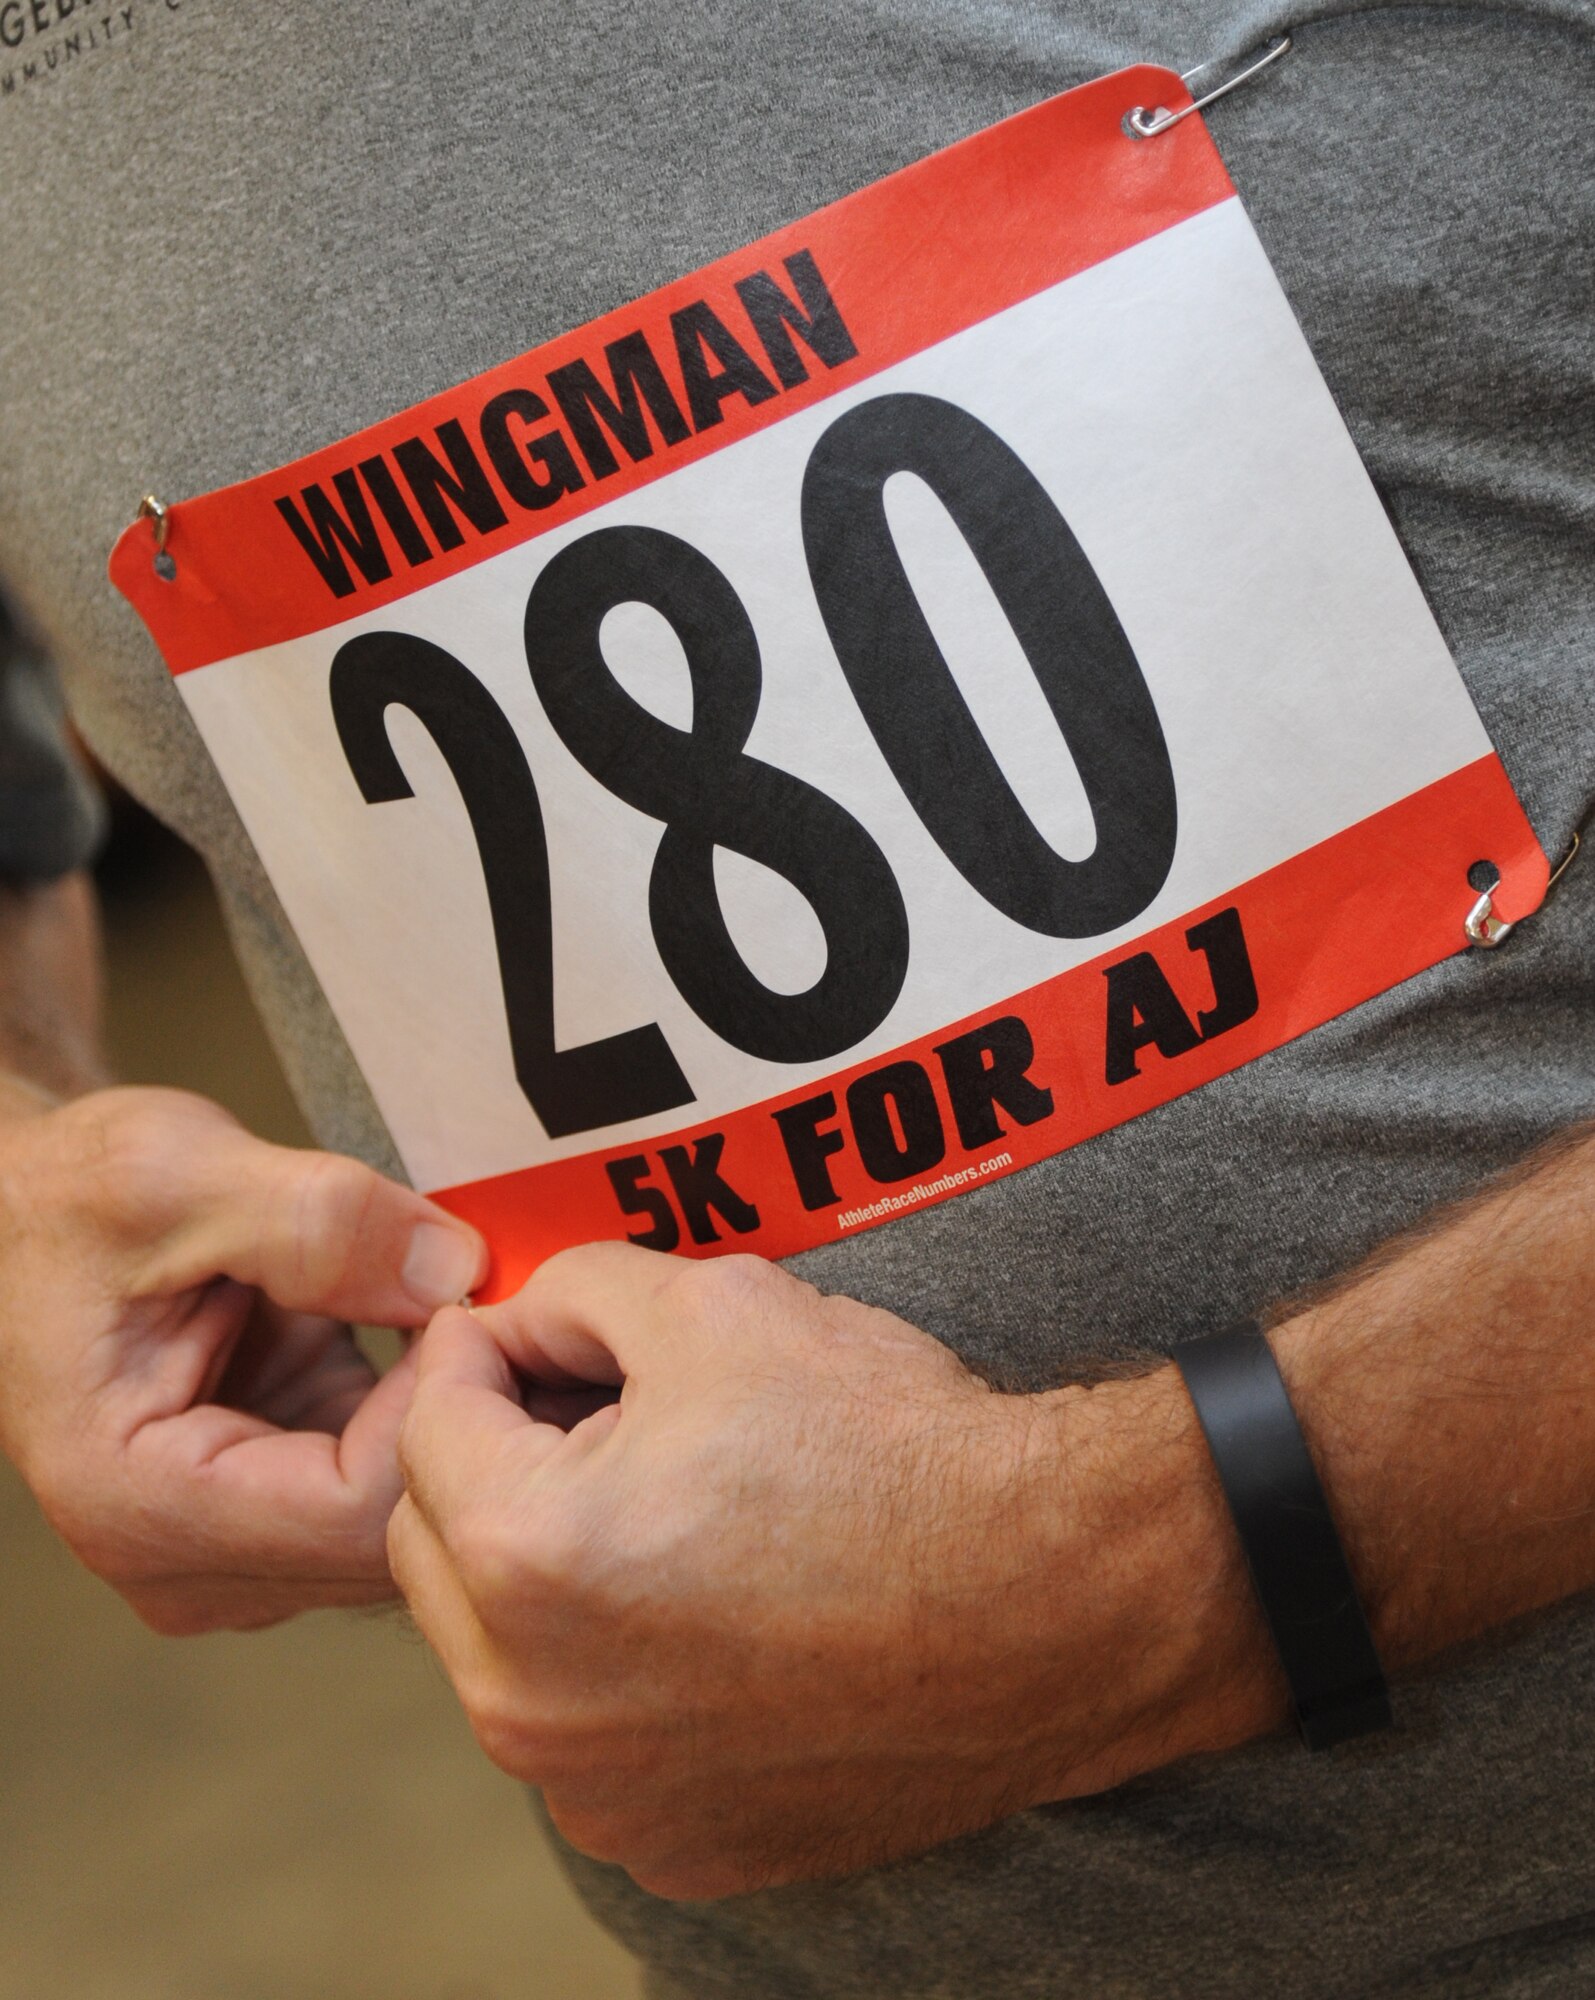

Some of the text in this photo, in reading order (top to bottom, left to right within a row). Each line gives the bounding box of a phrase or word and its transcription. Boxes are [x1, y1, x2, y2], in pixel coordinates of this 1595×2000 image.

[274, 248, 859, 599] WINGMAN
[329, 394, 1178, 1139] 280
[605, 907, 1259, 1253] 5K FOR AJ
[837, 1152, 1013, 1230] AthleteRaceNumbers.com
